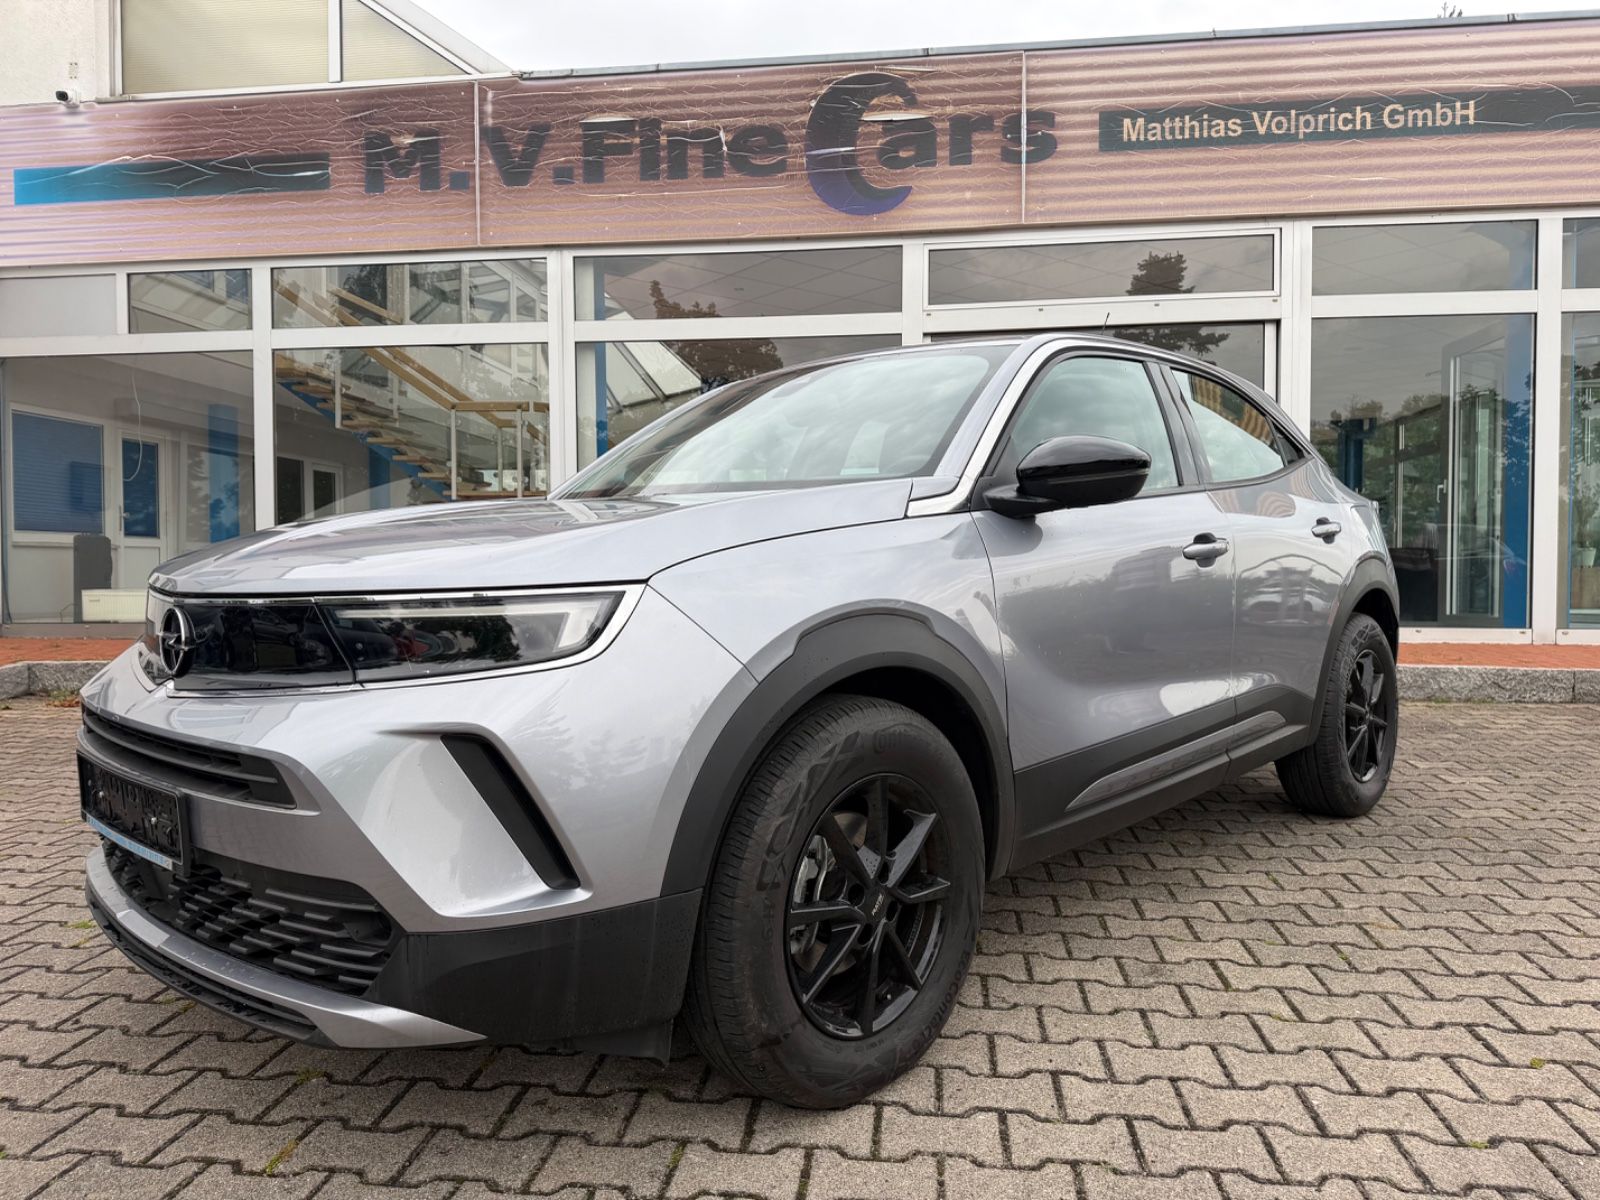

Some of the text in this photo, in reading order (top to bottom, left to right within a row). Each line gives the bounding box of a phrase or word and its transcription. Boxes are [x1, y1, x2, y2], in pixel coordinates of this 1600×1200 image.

[805, 71, 1058, 217] Cars
[1122, 100, 1476, 142] Matthias Volprich GmbH
